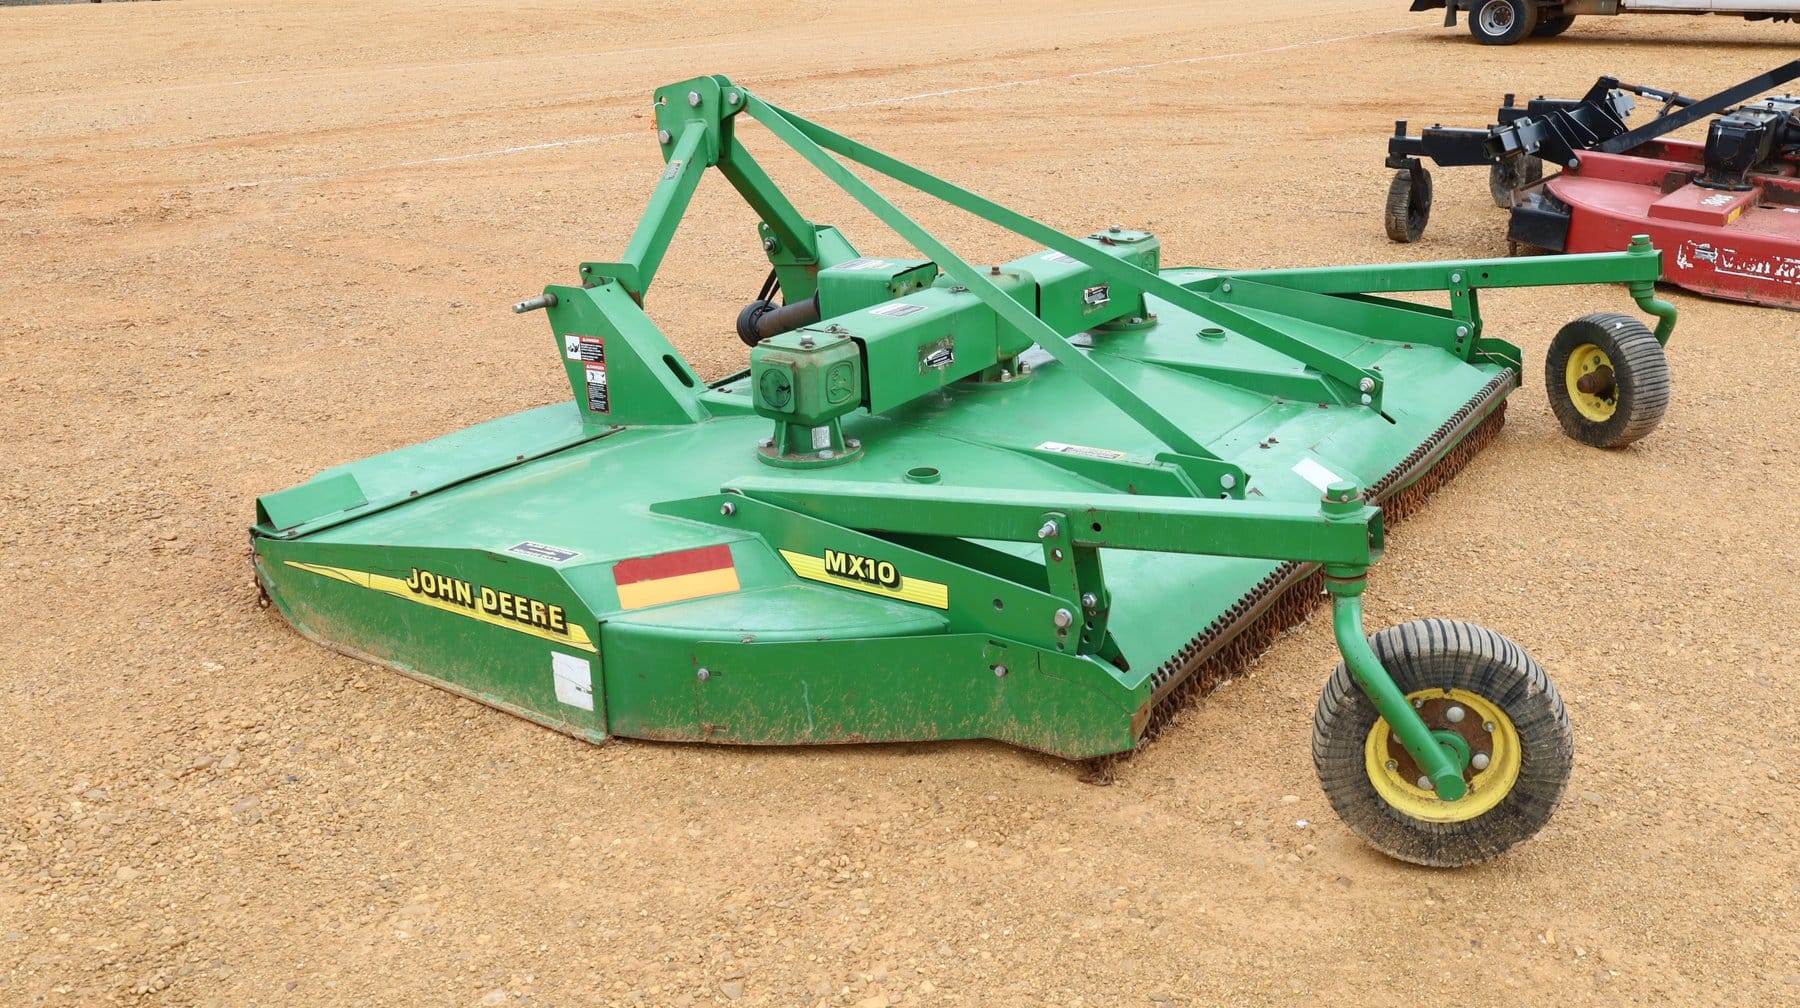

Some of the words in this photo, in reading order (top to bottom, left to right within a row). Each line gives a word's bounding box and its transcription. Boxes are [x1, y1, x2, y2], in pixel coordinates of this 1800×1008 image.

[825, 549, 898, 587] MX10
[406, 567, 474, 608] JOHN
[480, 586, 567, 633] DEERE
